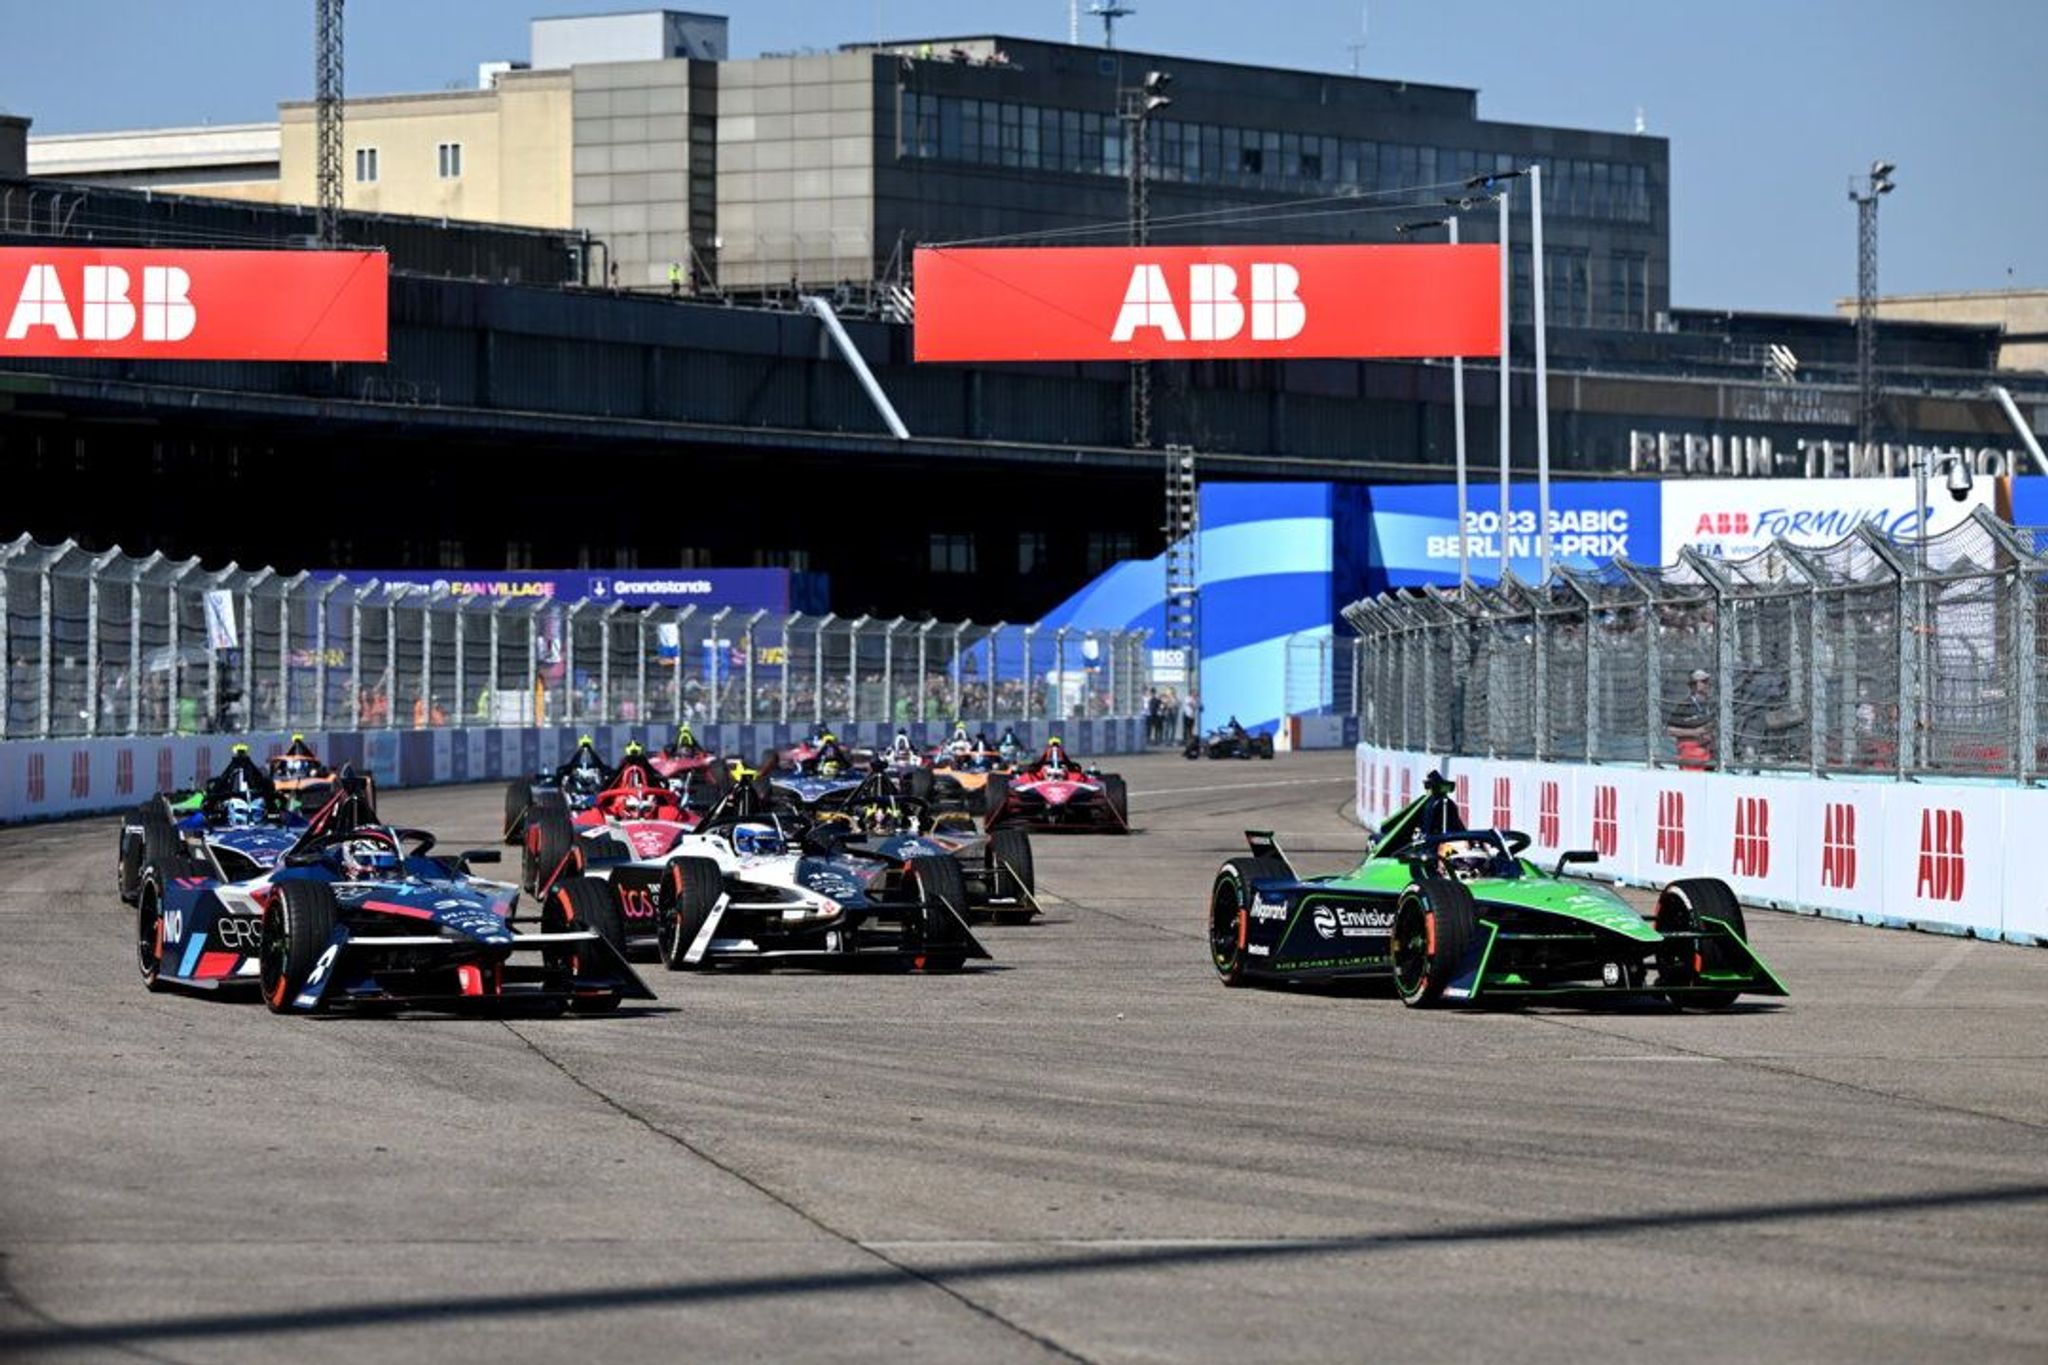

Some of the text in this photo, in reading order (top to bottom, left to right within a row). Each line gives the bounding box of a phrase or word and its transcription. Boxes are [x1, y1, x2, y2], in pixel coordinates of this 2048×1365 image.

[5, 264, 196, 341] ABB
[1110, 263, 1307, 341] ABB
[1427, 535, 1530, 557] BERLN
[1464, 509, 1628, 534] 2023 SABIC
[1696, 513, 1749, 535] ABB
[452, 582, 486, 596] FAN
[487, 582, 555, 597] VILLAGE
[614, 579, 712, 594] Grandstands
[1592, 785, 1618, 857] ABB
[1656, 791, 1685, 866] ABB
[1732, 797, 1769, 878] ABB
[1822, 803, 1856, 889] ABB
[1917, 808, 1965, 902] ABB
[617, 883, 654, 918] tcs
